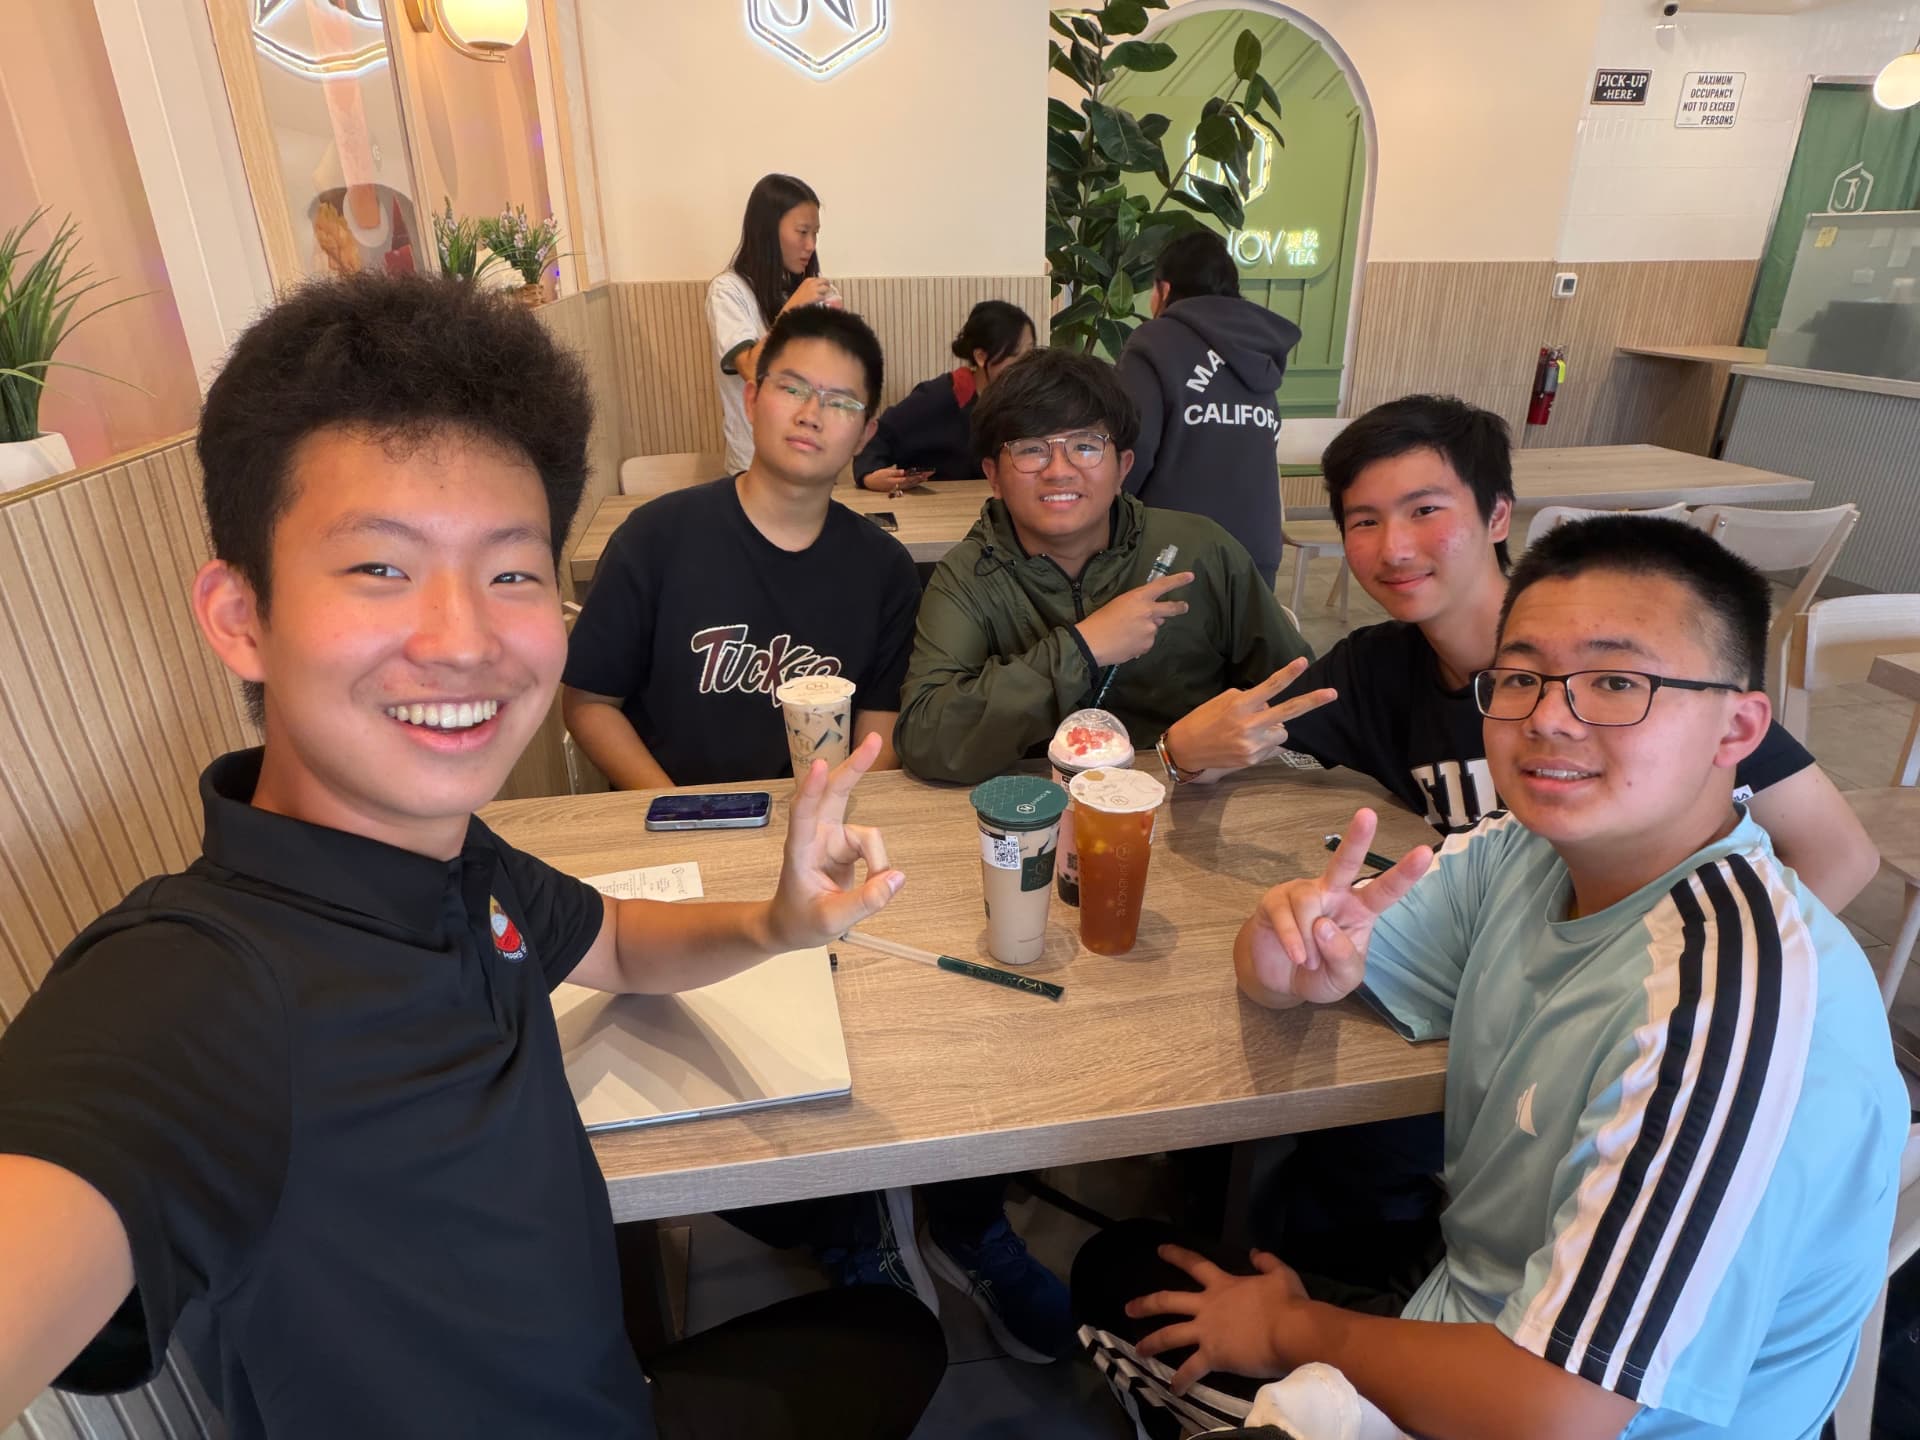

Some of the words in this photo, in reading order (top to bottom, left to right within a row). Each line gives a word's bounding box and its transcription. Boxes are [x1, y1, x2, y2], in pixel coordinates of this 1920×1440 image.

[1598, 74, 1648, 87] PICK-UP
[1697, 75, 1733, 85] MAXIMUM
[1690, 88, 1734, 98] OCCUPANCY
[1683, 101, 1698, 112] NOT
[1698, 101, 1708, 112] TO
[1709, 101, 1736, 112] EXCEED
[1700, 115, 1734, 125] PERSONS
